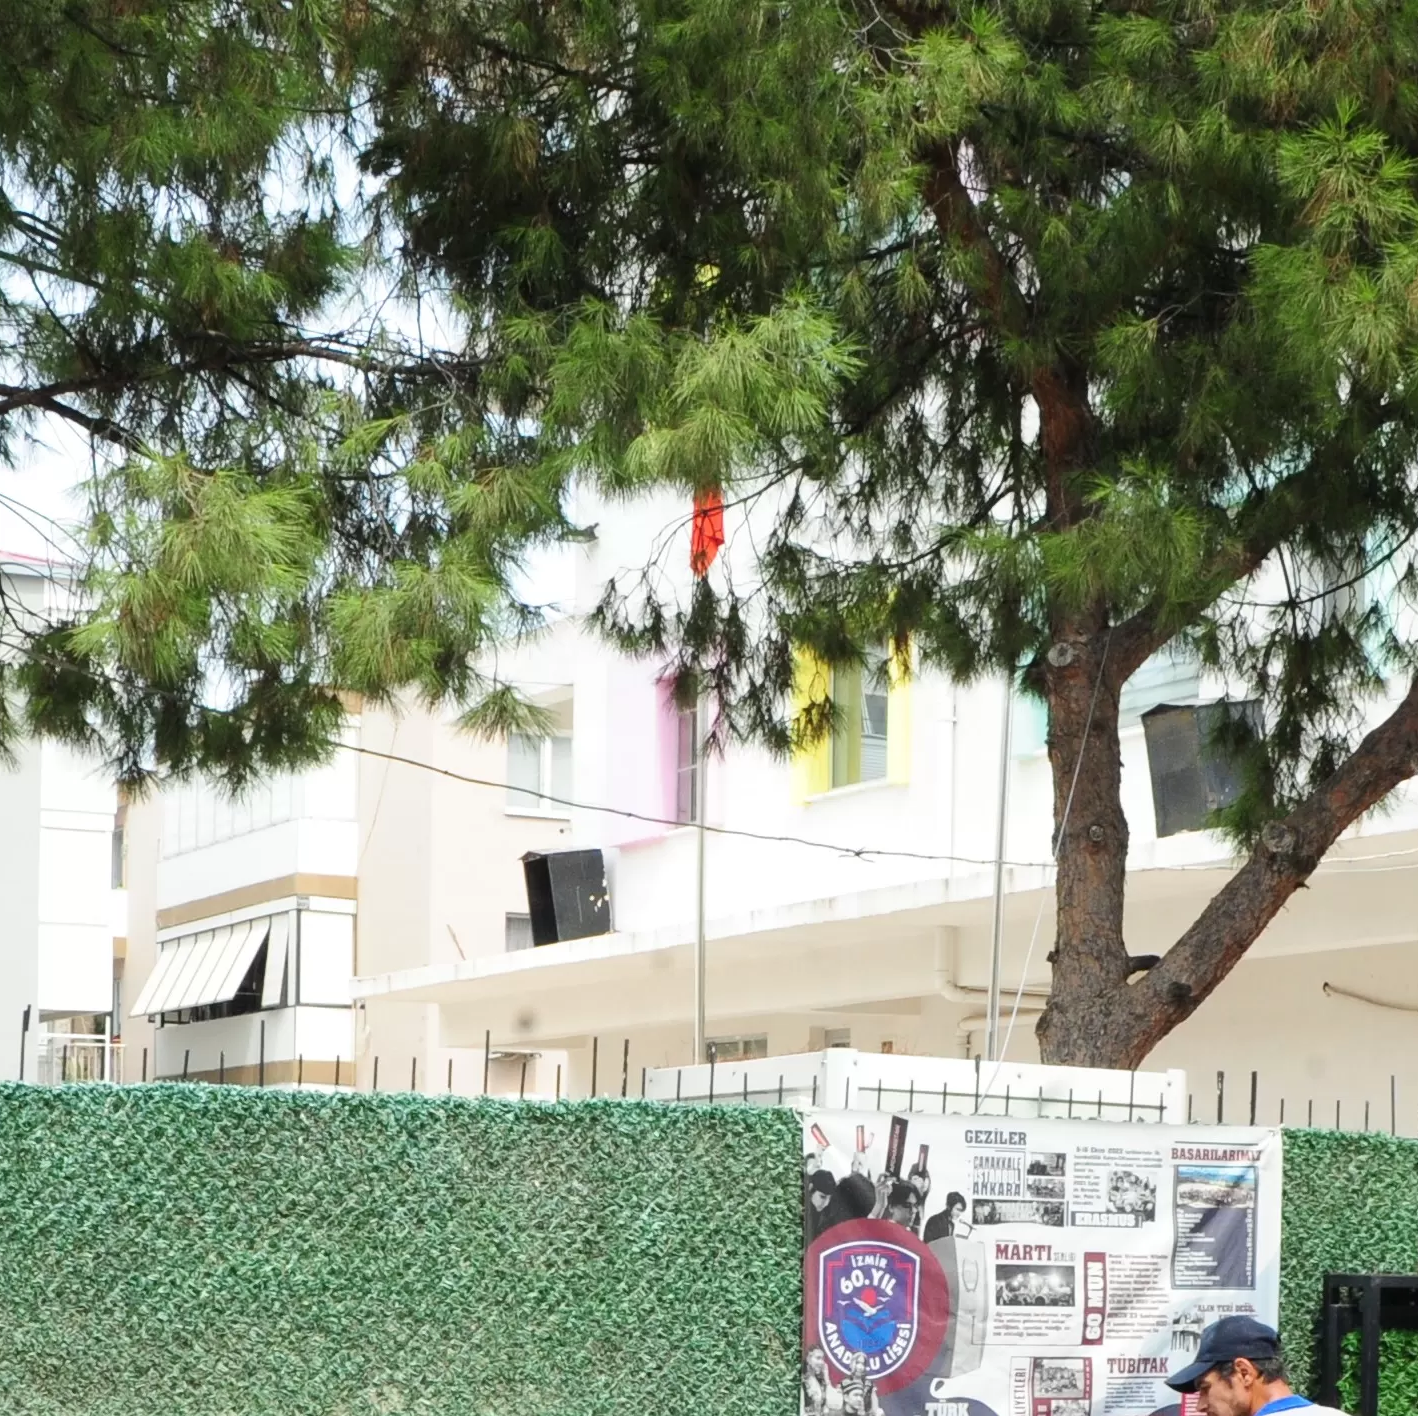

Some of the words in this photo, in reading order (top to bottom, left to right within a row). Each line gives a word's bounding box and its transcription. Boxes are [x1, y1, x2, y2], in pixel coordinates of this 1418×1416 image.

[964, 1128, 1027, 1146] GEZİLER
[973, 1181, 1021, 1197] ANKARA
[850, 1253, 888, 1269] İZMİR
[995, 1243, 1053, 1261] MARTI
[839, 1267, 897, 1296] 60.YIL
[825, 1322, 880, 1372] ANADU
[882, 1323, 912, 1366] LİSESİ
[1106, 1353, 1169, 1374] TÜBİTAK
